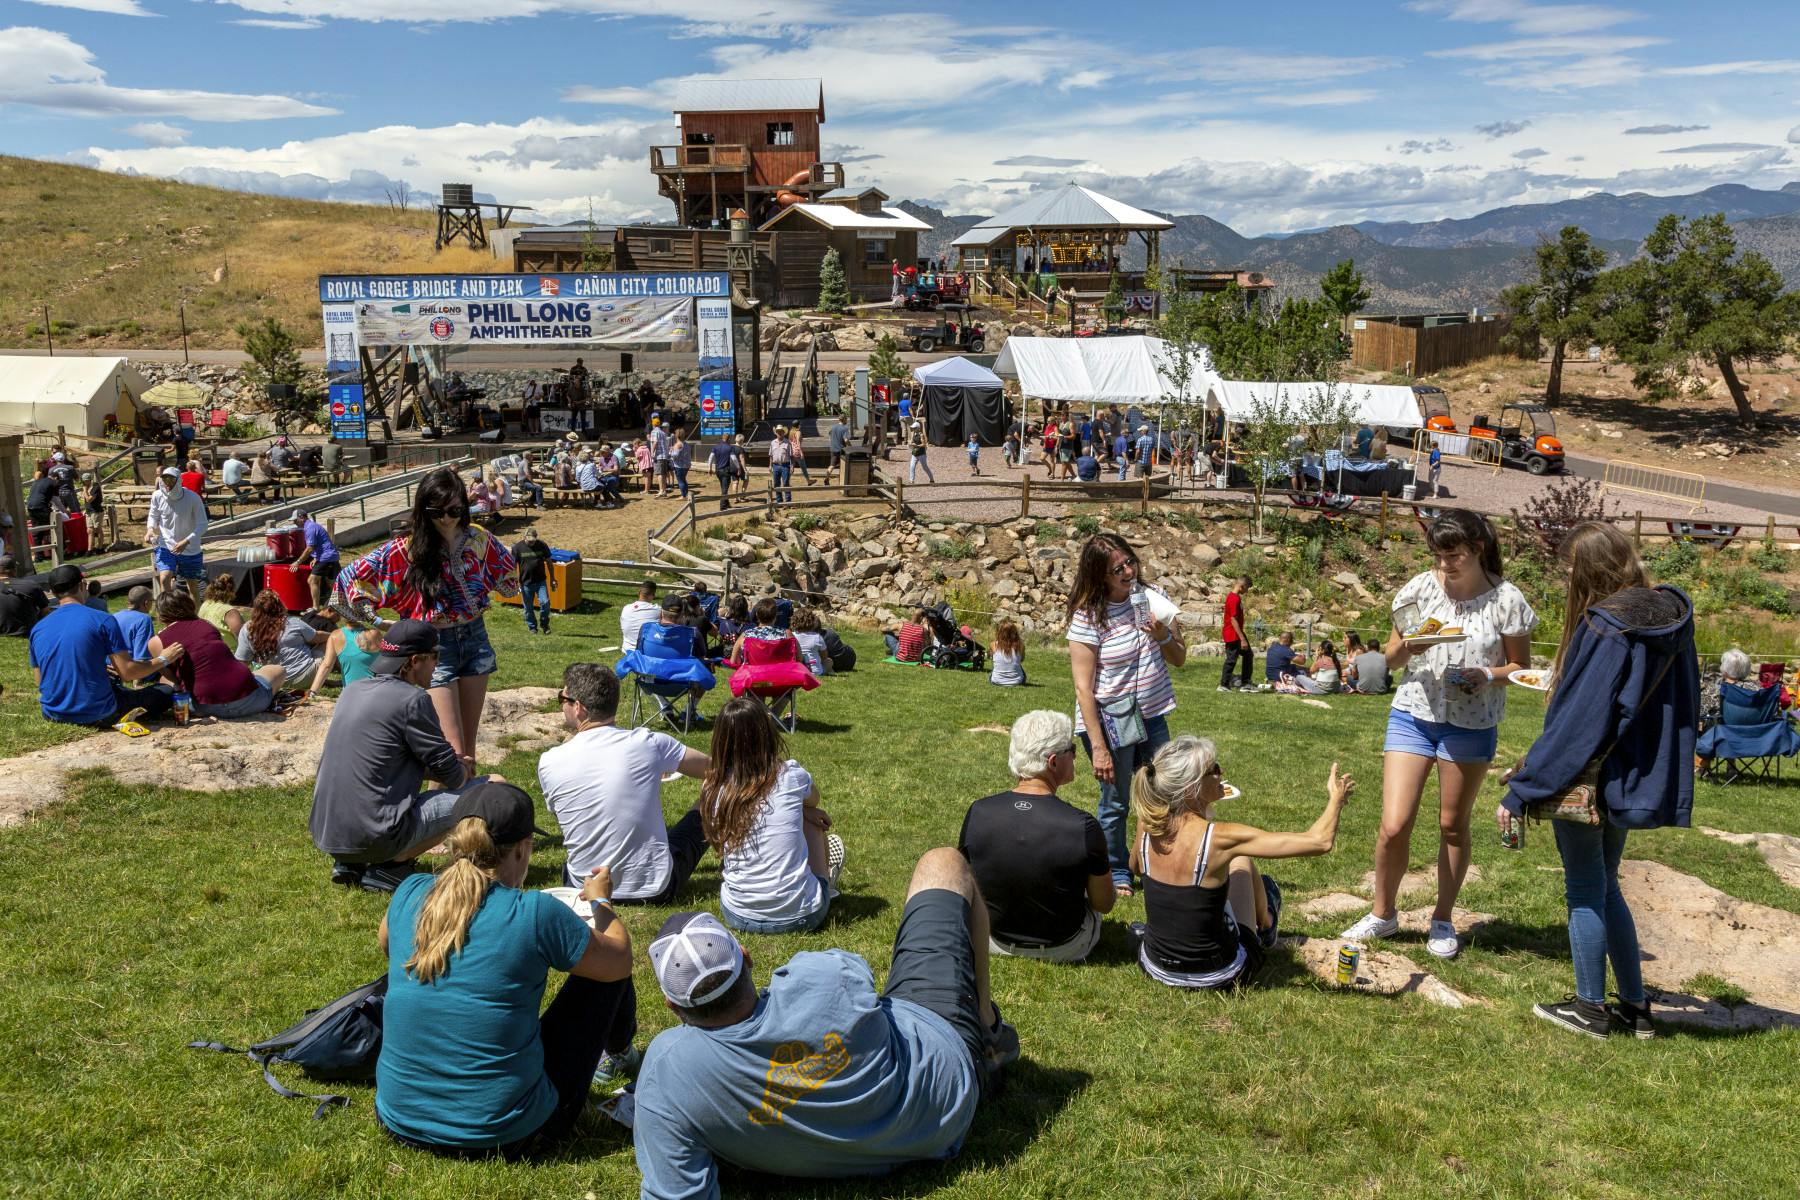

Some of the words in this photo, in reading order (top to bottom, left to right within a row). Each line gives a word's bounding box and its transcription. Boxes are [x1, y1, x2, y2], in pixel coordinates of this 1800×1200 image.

[327, 281, 366, 299] ROYAL
[369, 280, 407, 298] GORGE
[412, 279, 457, 298] BRIDGE
[461, 279, 486, 297] AND
[491, 279, 524, 296] PARK
[575, 275, 617, 295] CAÑON
[621, 277, 653, 297] CITY,
[656, 276, 721, 294] COLORADO
[418, 306, 437, 314] PHIL
[467, 303, 521, 323] PHIL
[526, 302, 592, 323] LONG
[469, 324, 592, 339] AMPHITHEATER
